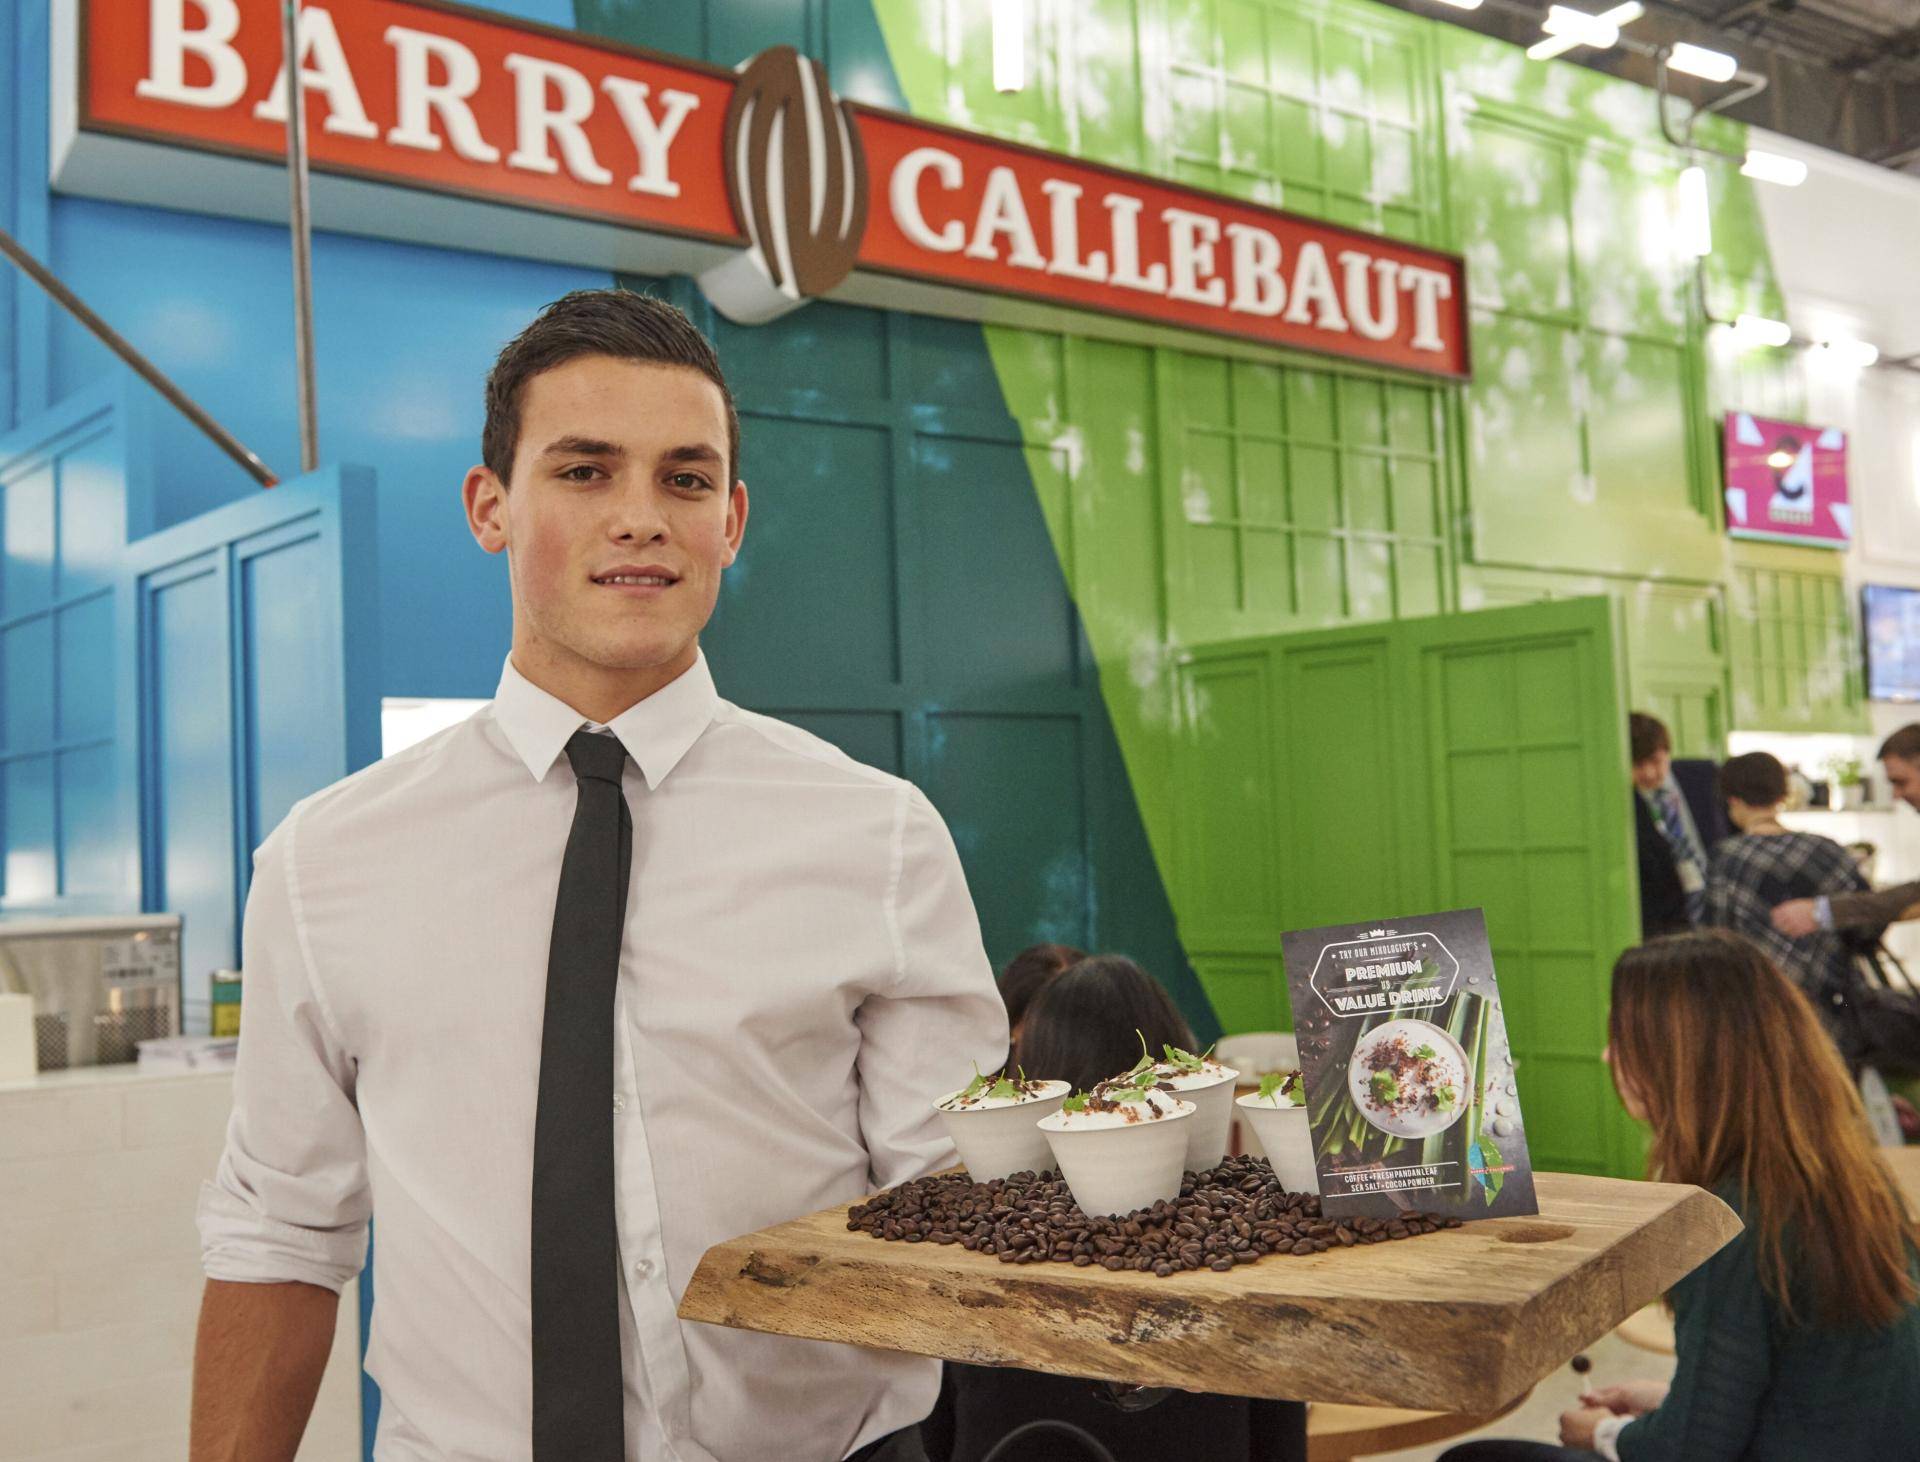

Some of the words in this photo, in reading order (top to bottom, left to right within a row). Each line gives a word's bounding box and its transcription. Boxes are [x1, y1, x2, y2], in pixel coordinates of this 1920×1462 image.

[136, 0, 700, 197] BARRY
[889, 147, 1451, 352] CALLEBAUT
[1339, 950, 1352, 960] TRY
[1354, 948, 1368, 958] OUR
[1370, 942, 1419, 956] MIXOLOGIST'S
[1345, 959, 1423, 982] PREMIUM
[1334, 992, 1387, 1011] VALUE
[1388, 986, 1443, 1006] DRINK
[1344, 1172, 1369, 1183] COFFEE
[1372, 1170, 1394, 1180] FRESH
[1395, 1168, 1421, 1179] PANDAN
[1421, 1166, 1438, 1176] LEAF
[1351, 1183, 1364, 1192] SEA
[1365, 1182, 1380, 1191] SALT
[1385, 1180, 1407, 1189] COCOA
[1407, 1177, 1435, 1187] POWDER
